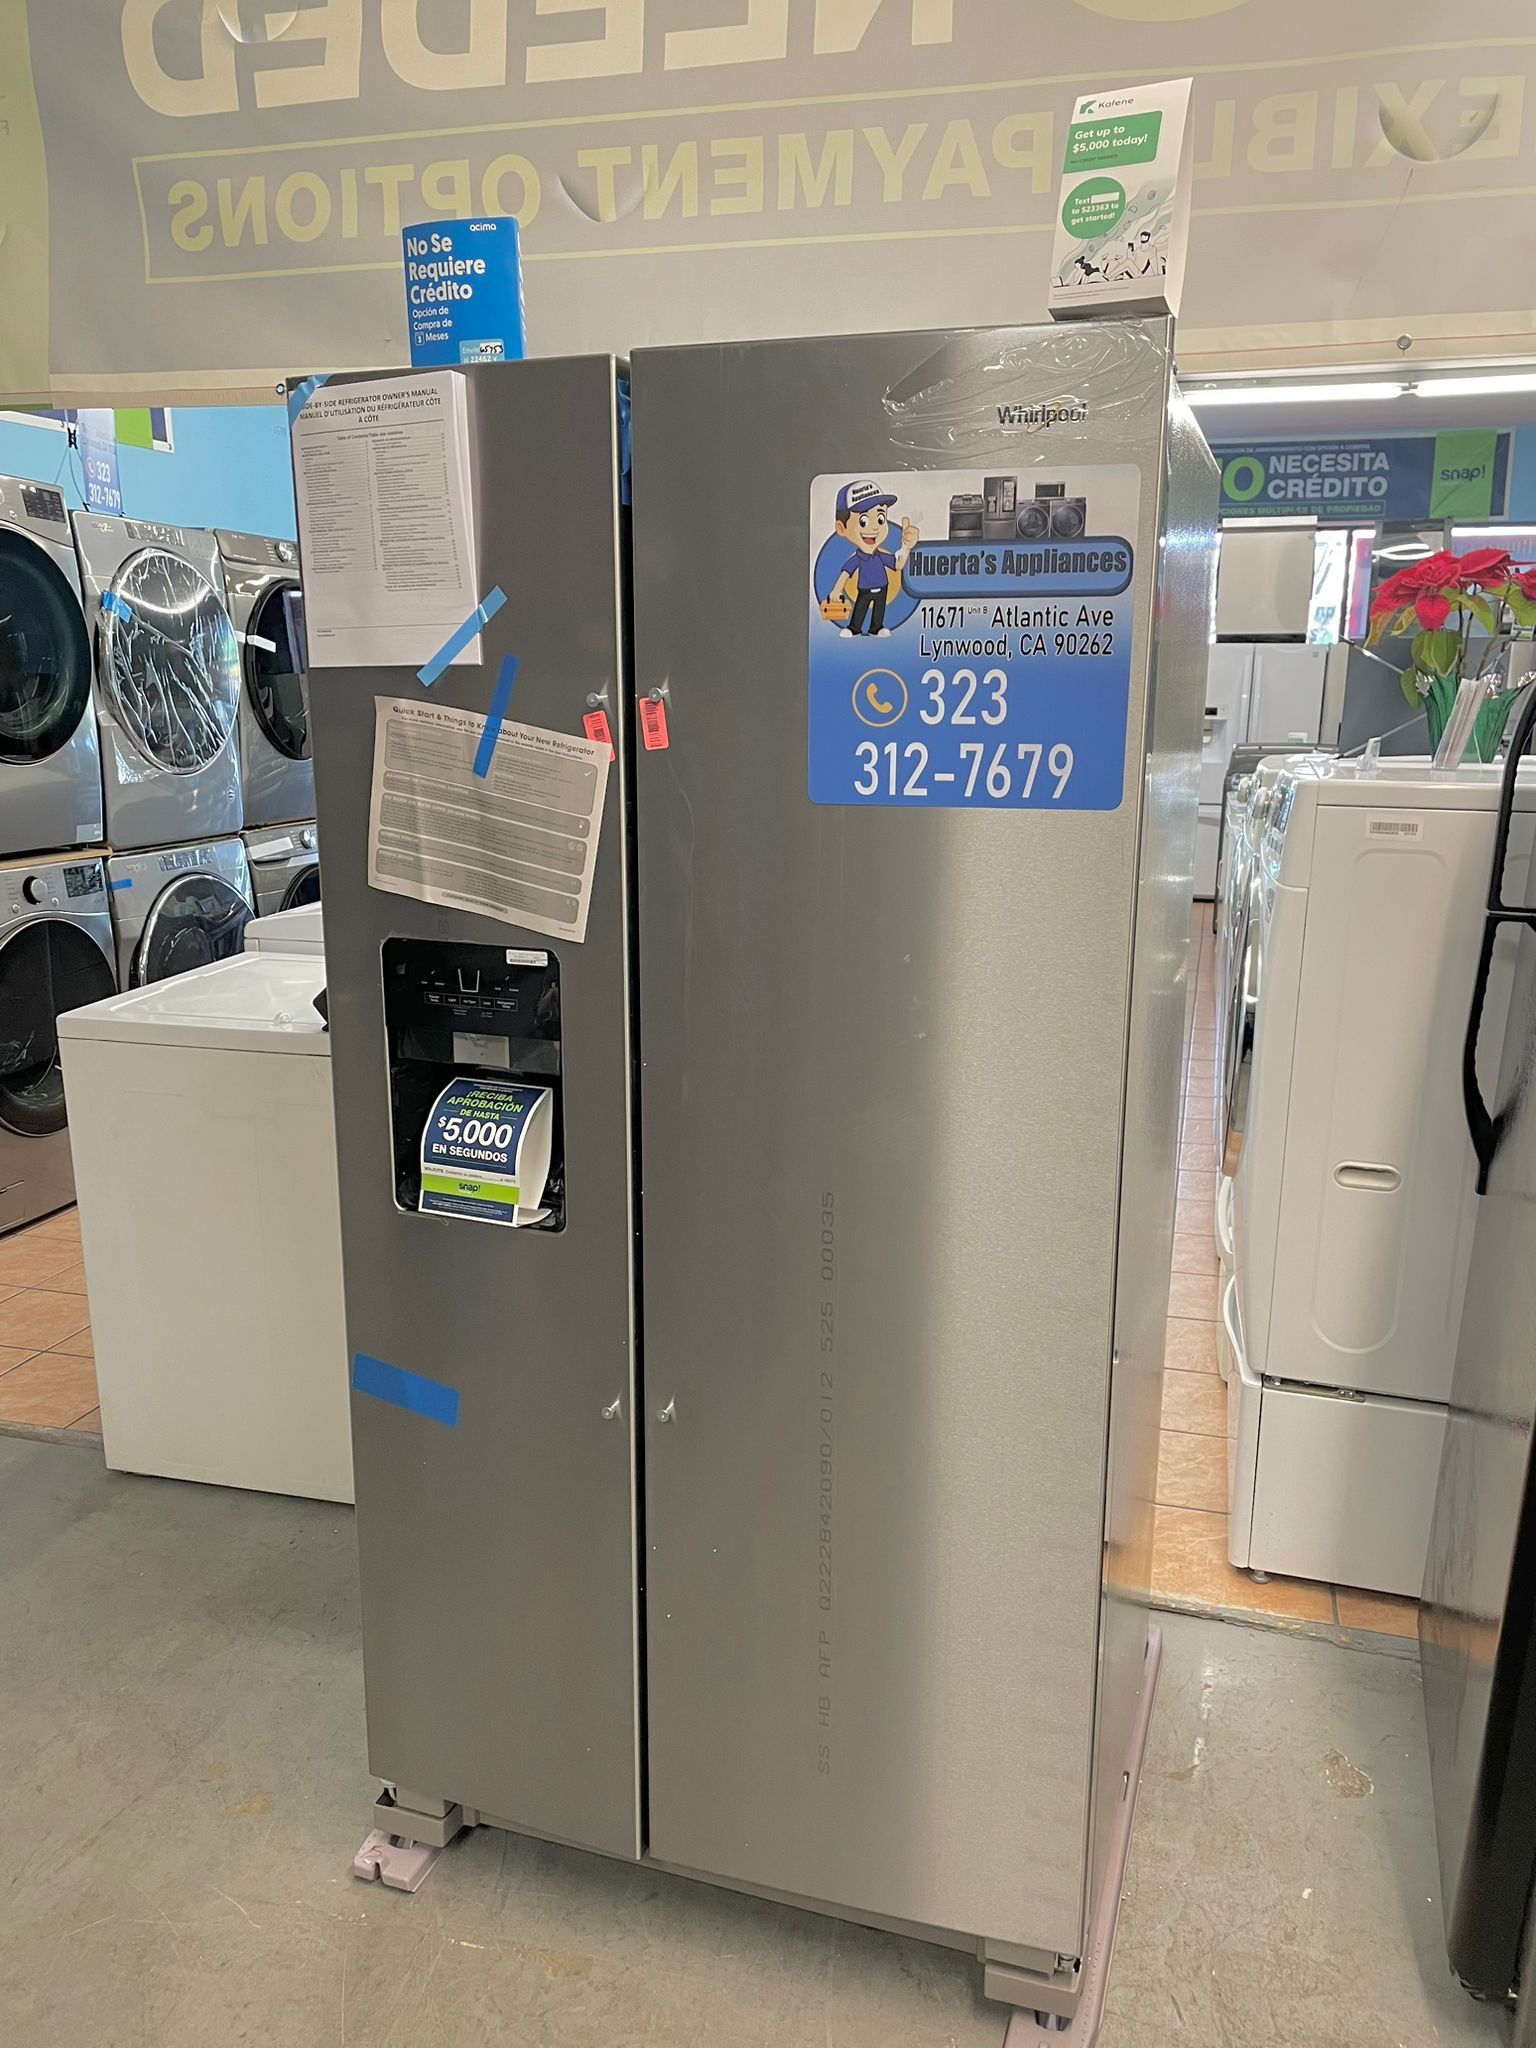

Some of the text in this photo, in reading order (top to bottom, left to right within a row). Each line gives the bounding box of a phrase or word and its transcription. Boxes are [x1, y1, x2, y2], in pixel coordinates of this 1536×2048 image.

[1098, 97, 1134, 109] Kafene
[1072, 134, 1148, 154] $5,000 today!
[1075, 126, 1126, 140] Get up to
[1074, 197, 1090, 205] Text
[469, 223, 497, 232] acima
[1071, 212, 1115, 226] get started!
[406, 233, 453, 257] No Se
[408, 255, 486, 282] Requiere
[410, 280, 473, 305] Crédito
[412, 305, 449, 319] Opción de
[413, 318, 453, 331] Compra de
[425, 332, 449, 342] Meses
[338, 394, 381, 406] REFRIGERATOR
[382, 391, 411, 401] OWNER'S
[411, 387, 438, 397] MANUAL
[300, 410, 323, 420] MANUEL
[377, 400, 424, 411] RÉFRIGÉRATEUR
[425, 397, 441, 406] CÔTE
[364, 414, 379, 423] CÔTE
[997, 402, 1088, 428] Whirlpool
[96, 461, 111, 483] 323
[1268, 452, 1390, 474] NECESITA
[1440, 464, 1486, 482] snap!
[88, 482, 120, 510] 312-7679
[1267, 471, 1388, 500] CRÉDITO
[1311, 505, 1324, 514] DE
[909, 548, 1128, 577] Huerta's Appliances
[920, 607, 965, 629] 11671
[967, 605, 981, 614] Unit
[991, 605, 1069, 629] Atlantic
[1075, 605, 1114, 629] Ave
[920, 633, 1113, 661] Lynwood, CA 90262
[919, 669, 1009, 726] 323
[393, 705, 415, 715] Quick
[417, 709, 435, 720] Start
[443, 714, 466, 726] Things
[468, 720, 475, 728] to
[498, 728, 518, 738] about
[520, 732, 535, 742] Your
[536, 736, 551, 746] New
[552, 740, 594, 756] Refrigerator
[853, 741, 1075, 799] 312-7679
[447, 1096, 523, 1114] APROBACIÓN
[467, 1090, 514, 1102] ¡RECIBA
[459, 1108, 501, 1121] DE HASTA
[432, 1143, 508, 1163] EN SEGUNDOS
[458, 1182, 481, 1193] snap!
[820, 1191, 835, 1281] 00035
[820, 1301, 835, 1353] 525
[818, 1630, 832, 1679] AFP
[817, 1696, 832, 1729] HB
[817, 1744, 831, 1775] SS
